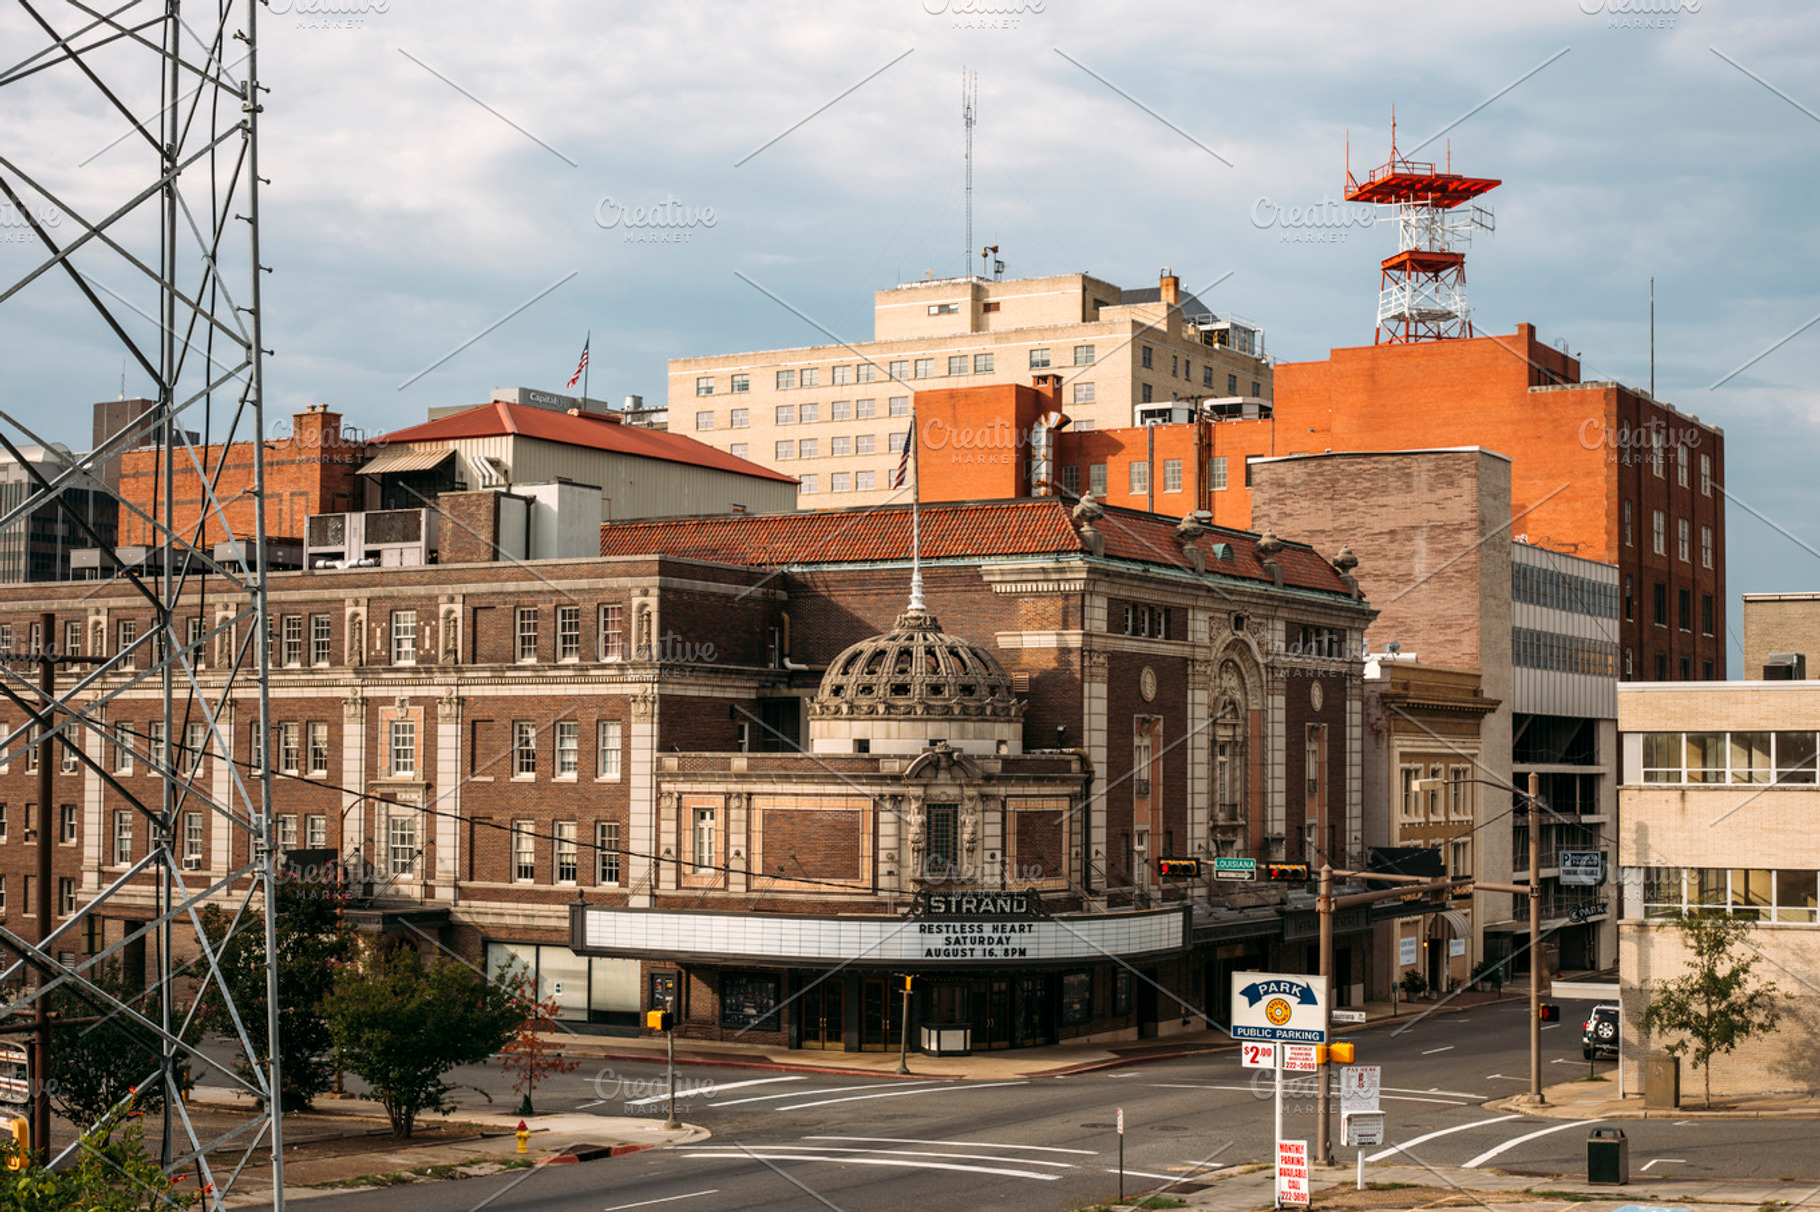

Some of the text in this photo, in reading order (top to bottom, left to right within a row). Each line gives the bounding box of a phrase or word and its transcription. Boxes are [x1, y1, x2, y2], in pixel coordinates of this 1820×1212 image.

[529, 392, 557, 405] Capital
[1215, 860, 1254, 868] LOUISIANA
[930, 897, 1027, 913] STRAND
[919, 924, 1033, 934] RESTLESS HEART
[944, 936, 1011, 946] SATURDAY
[925, 948, 975, 957] AUGUST
[1003, 947, 1027, 957] 8PM
[1258, 982, 1302, 997] PARK
[1237, 1027, 1320, 1040] PUBLIC PARKING
[1244, 1045, 1273, 1064] $2.00
[1279, 1143, 1304, 1154] MONTHLY
[1280, 1155, 1305, 1166] PARKING
[1279, 1167, 1307, 1179] AVAILABLE
[1287, 1179, 1301, 1190] CALL
